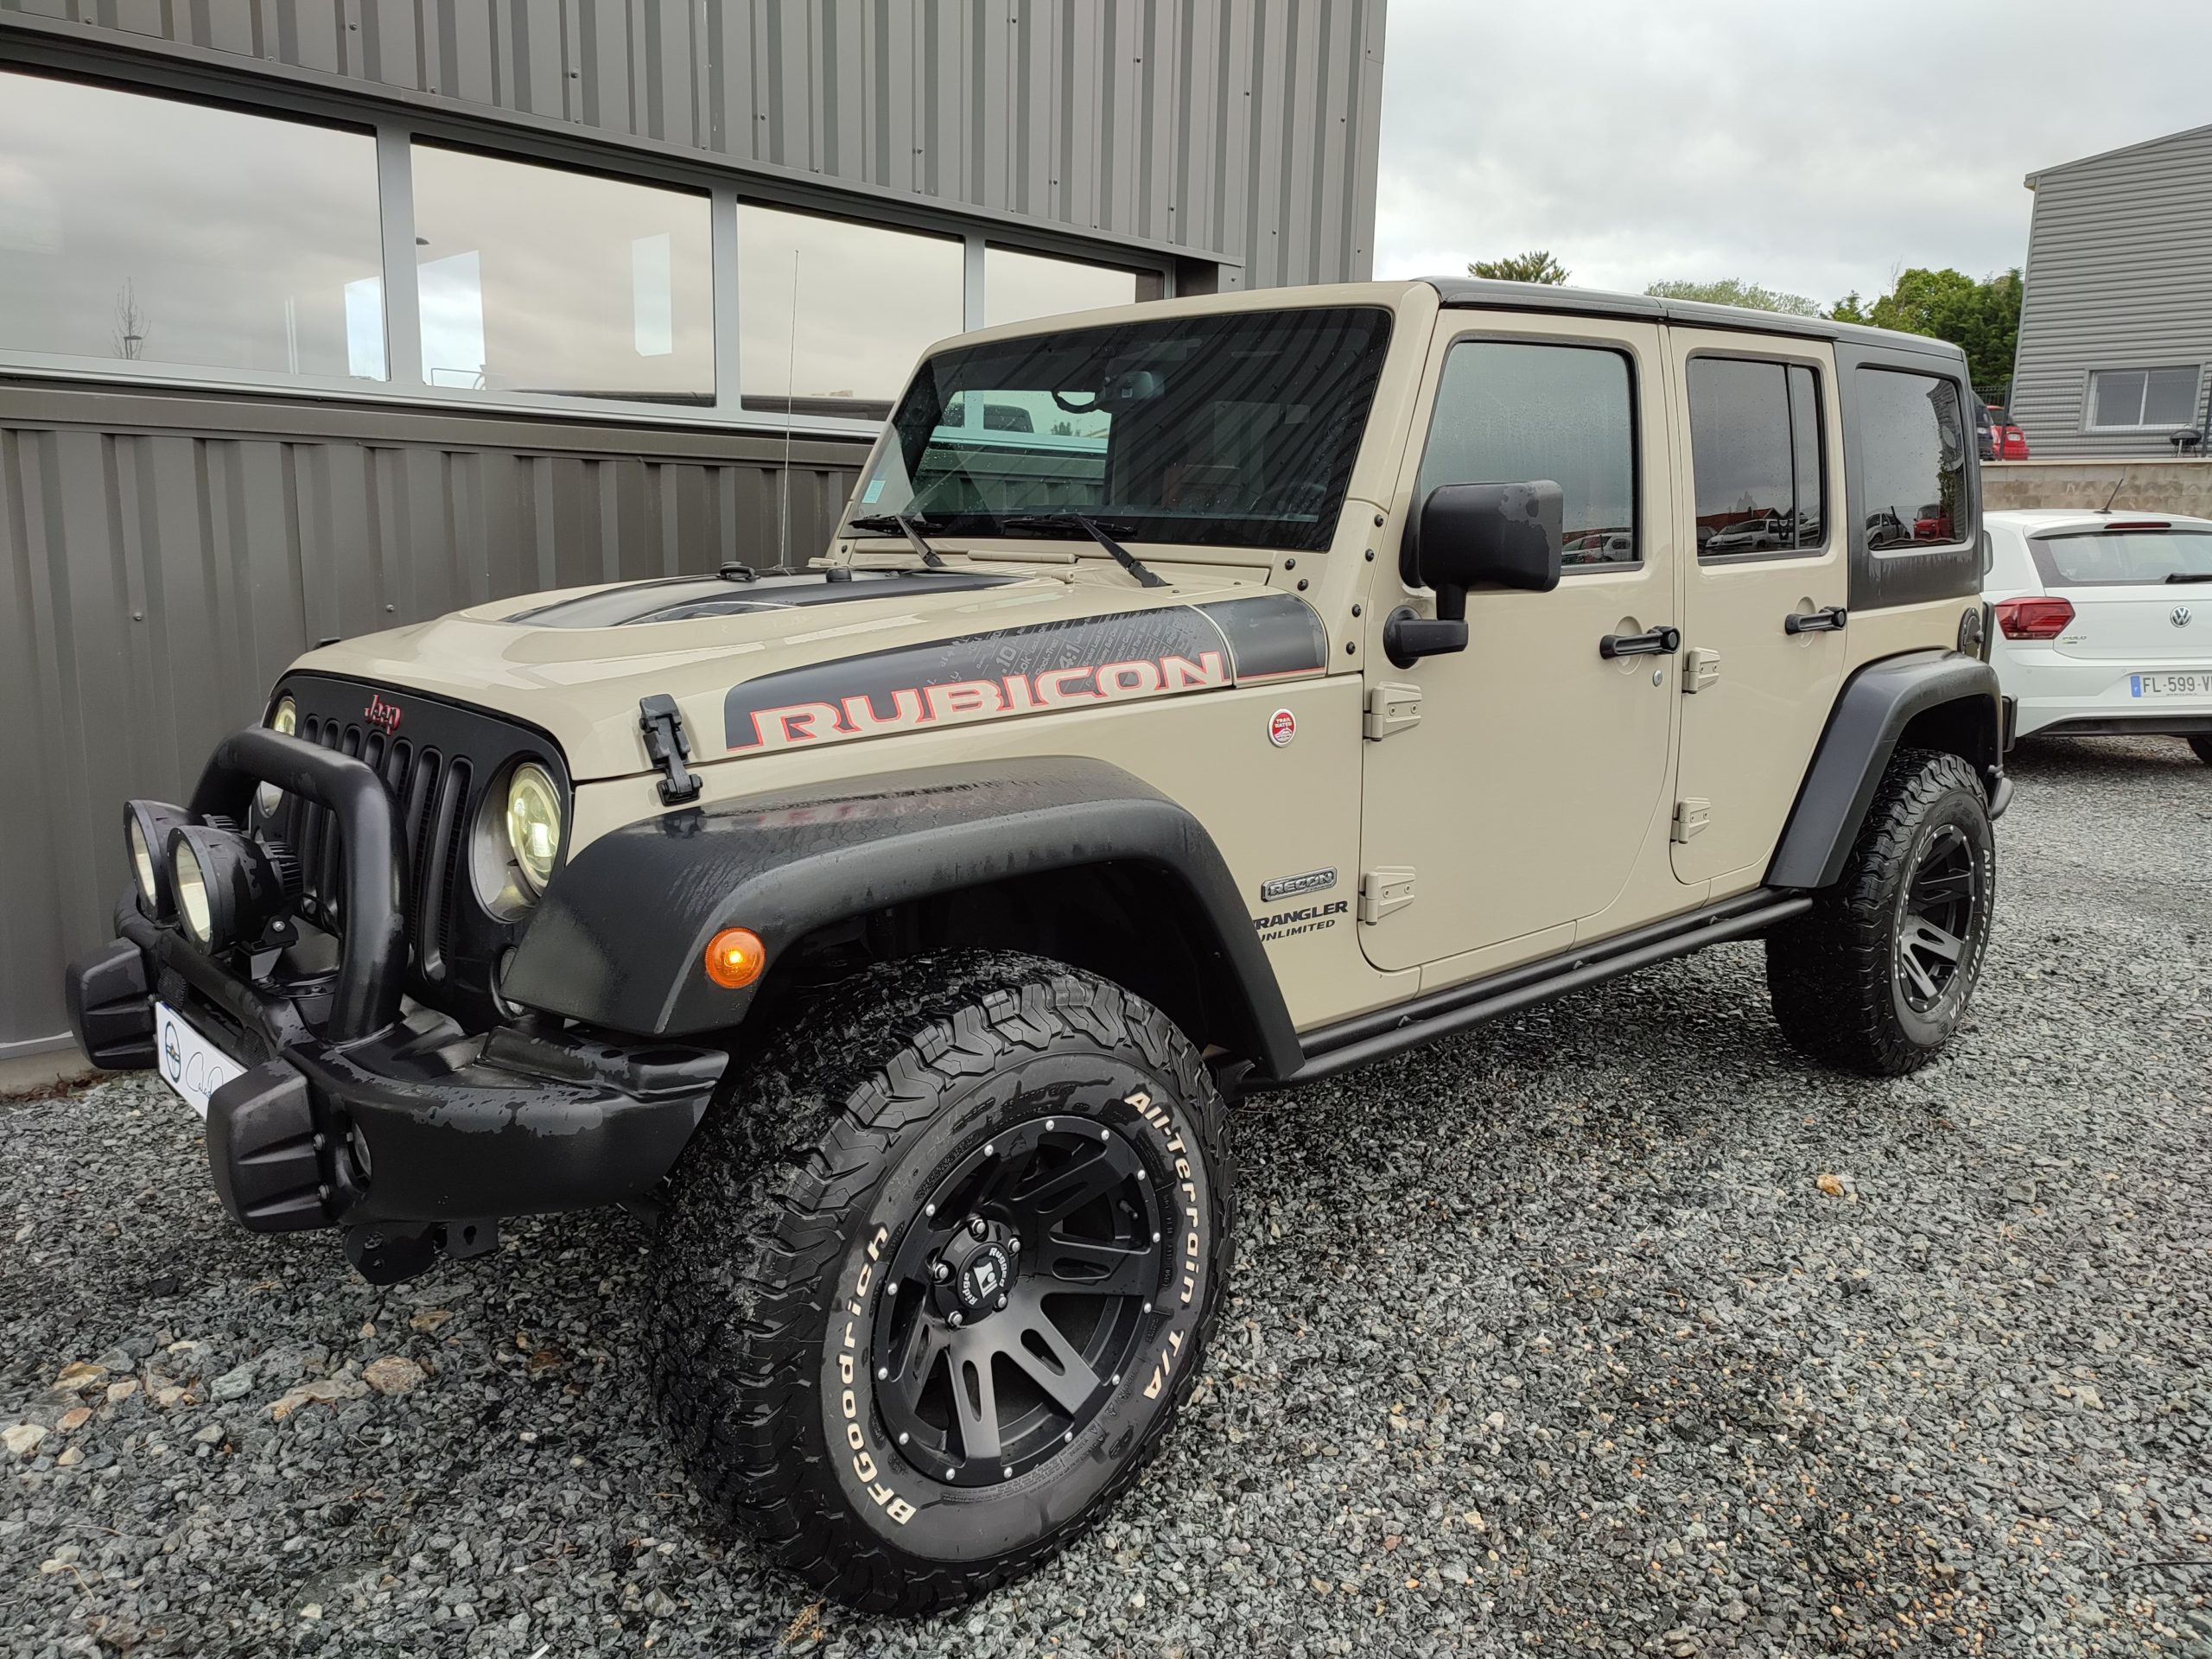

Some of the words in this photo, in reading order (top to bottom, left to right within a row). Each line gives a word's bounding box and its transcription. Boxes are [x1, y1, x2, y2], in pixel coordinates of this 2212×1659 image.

[748, 651, 1231, 745] RUBICON
[2143, 676, 2212, 693] FL-599-V
[364, 694, 401, 736] Jeep
[1268, 870, 1334, 896] RECON
[1253, 900, 1348, 931] RANGLER
[1124, 1090, 1201, 1304] All-Terrain
[988, 1247, 1007, 1287] Rugged
[962, 1272, 978, 1306] Ridge
[837, 1227, 917, 1525] BFGoodrich
[1143, 1329, 1185, 1400] T/A
